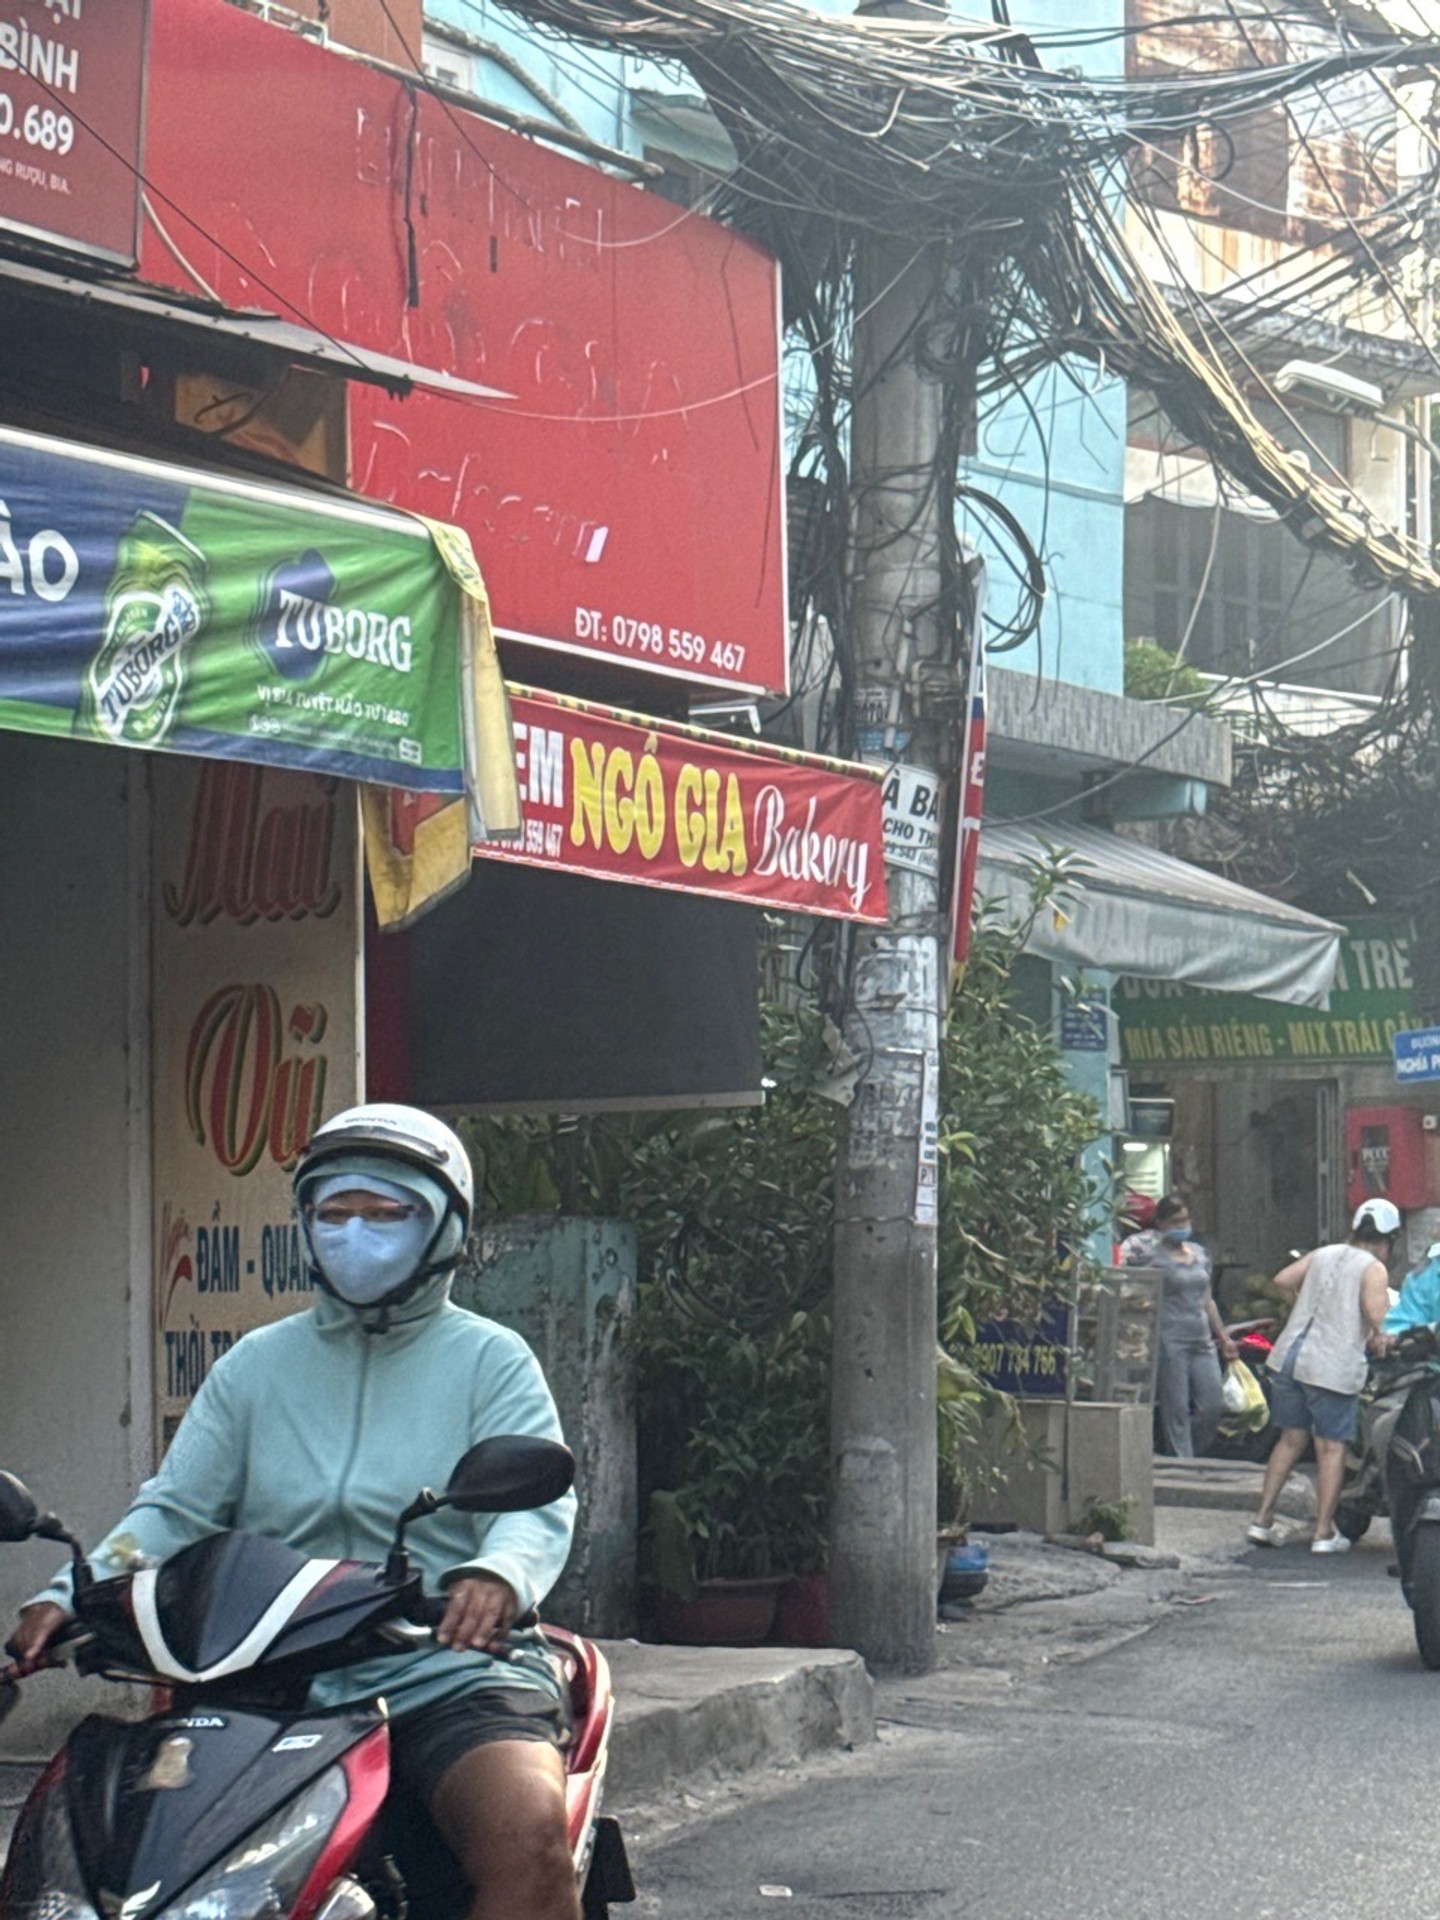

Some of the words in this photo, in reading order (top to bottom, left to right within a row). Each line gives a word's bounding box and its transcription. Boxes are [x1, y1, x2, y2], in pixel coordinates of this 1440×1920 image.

[101, 613, 180, 724] TUBORG
[275, 589, 412, 673] TUBORG
[575, 606, 607, 643] ĐT:
[612, 615, 664, 655] 0798
[668, 628, 706, 664] 559
[710, 640, 746, 673] 467
[675, 763, 748, 877] GIA
[753, 784, 873, 912] Bakery
[883, 817, 915, 840] CHO
[1288, 1021, 1332, 1055] MIX
